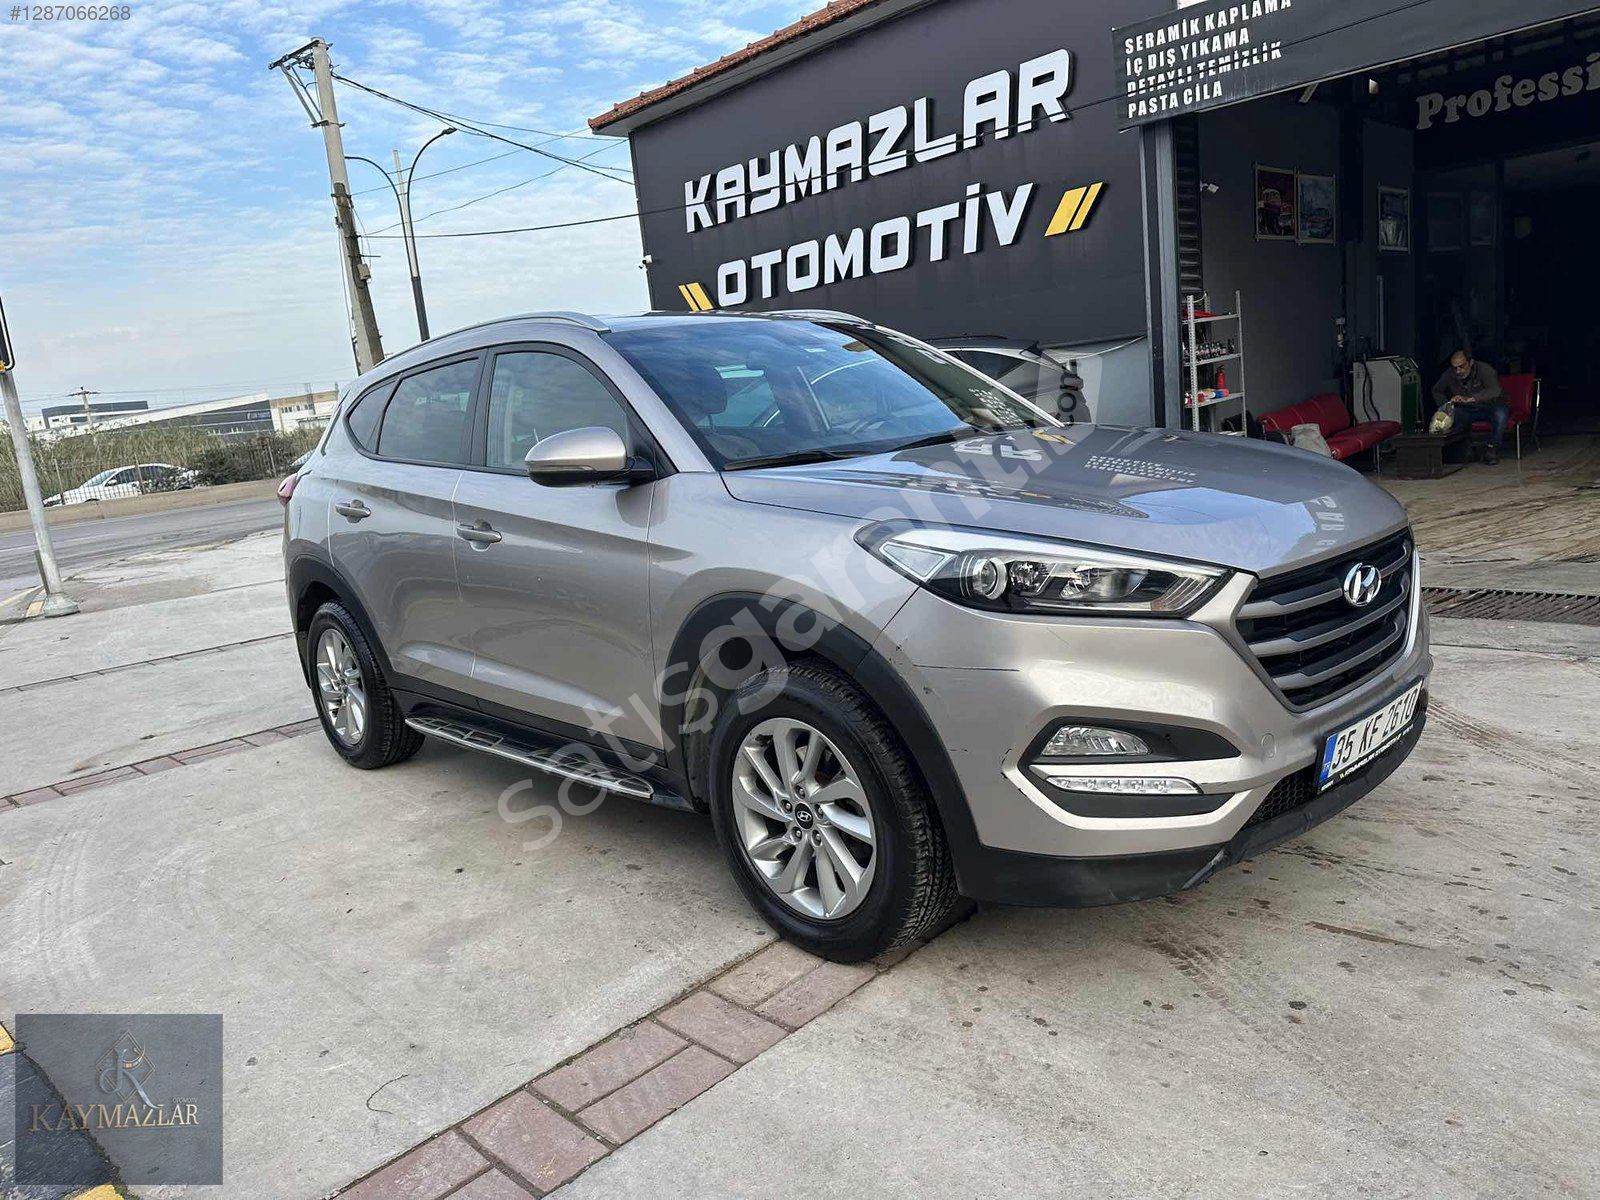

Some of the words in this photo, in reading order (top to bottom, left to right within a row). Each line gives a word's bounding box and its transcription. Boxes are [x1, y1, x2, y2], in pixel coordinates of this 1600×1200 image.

[1125, 18, 1200, 54] SERAMİK
[1126, 57, 1143, 76] İÇ
[1147, 48, 1176, 70] DIŞ
[1180, 27, 1250, 61] YIKAMA
[1128, 93, 1179, 119] PASTA
[1183, 81, 1223, 105] CİLA
[684, 48, 1071, 233] KAYMAZLAR
[717, 182, 1035, 307] OTOMOTİV
[1332, 729, 1357, 769] 35
[1382, 688, 1419, 738] 2610
